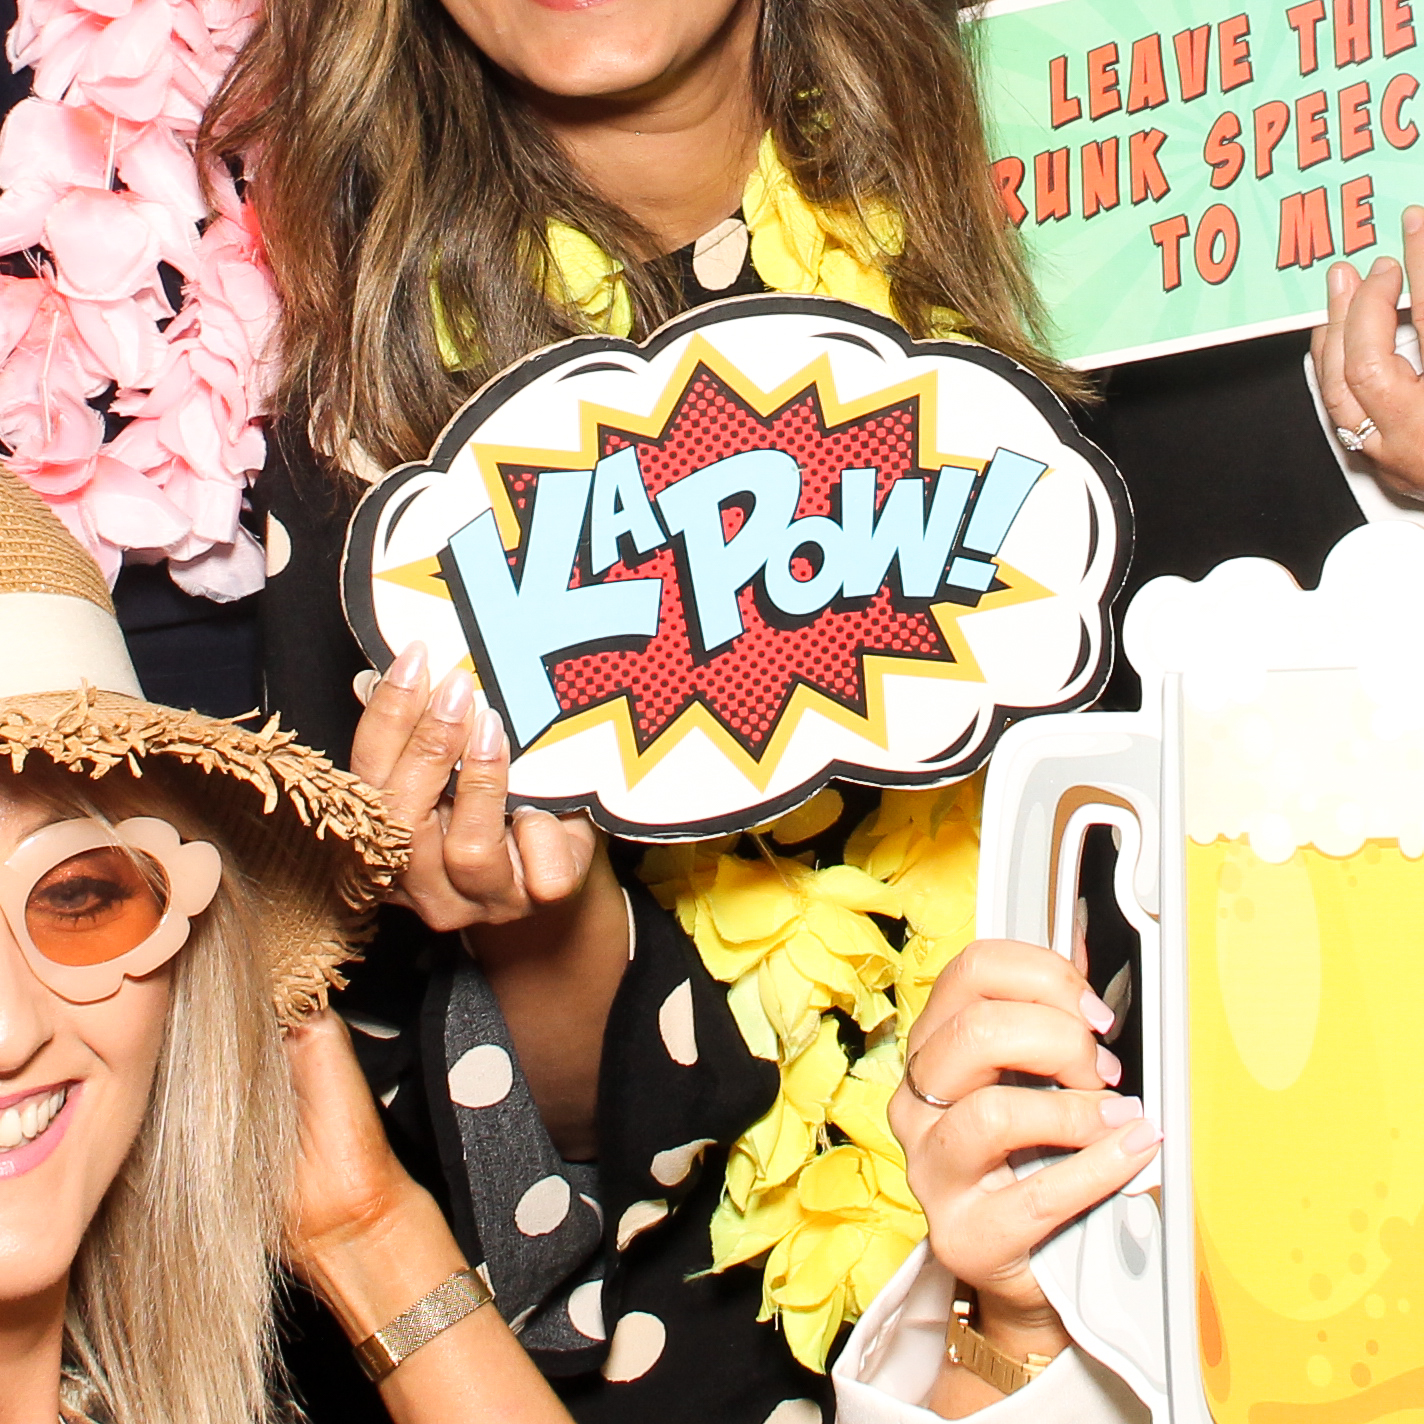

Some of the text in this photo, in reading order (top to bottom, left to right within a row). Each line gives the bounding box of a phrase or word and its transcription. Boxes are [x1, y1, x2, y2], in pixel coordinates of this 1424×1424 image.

[1048, 13, 1254, 130] LEAVE
[990, 127, 1171, 230] RUNK
[1150, 174, 1378, 293] TO ME
